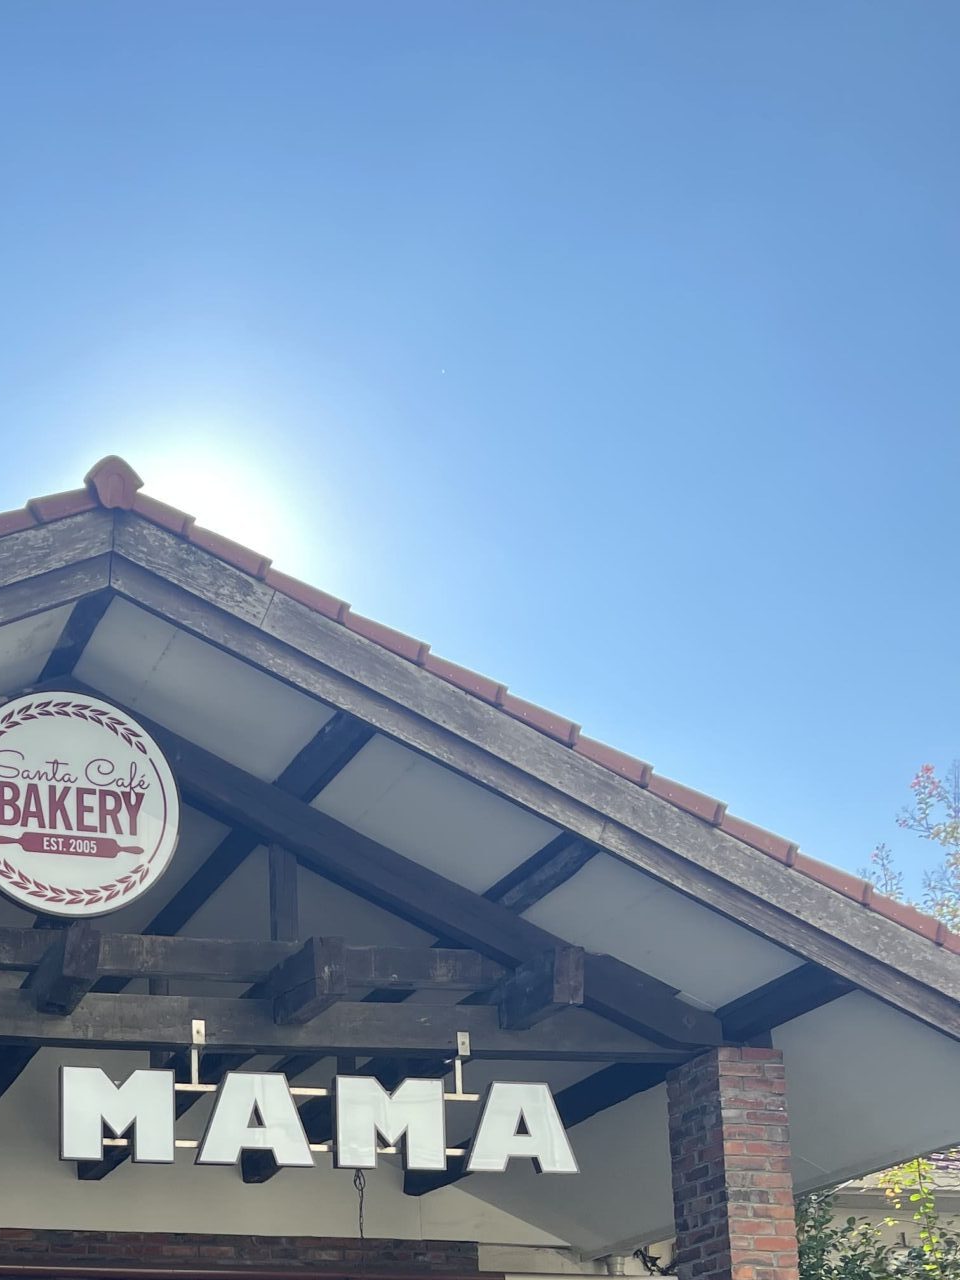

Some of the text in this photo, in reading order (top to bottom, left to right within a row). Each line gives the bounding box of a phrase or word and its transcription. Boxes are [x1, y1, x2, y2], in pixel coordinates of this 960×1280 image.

[85, 758, 150, 798] Café
[43, 837, 97, 853] EST. 2005
[59, 1065, 580, 1174] MAMA
